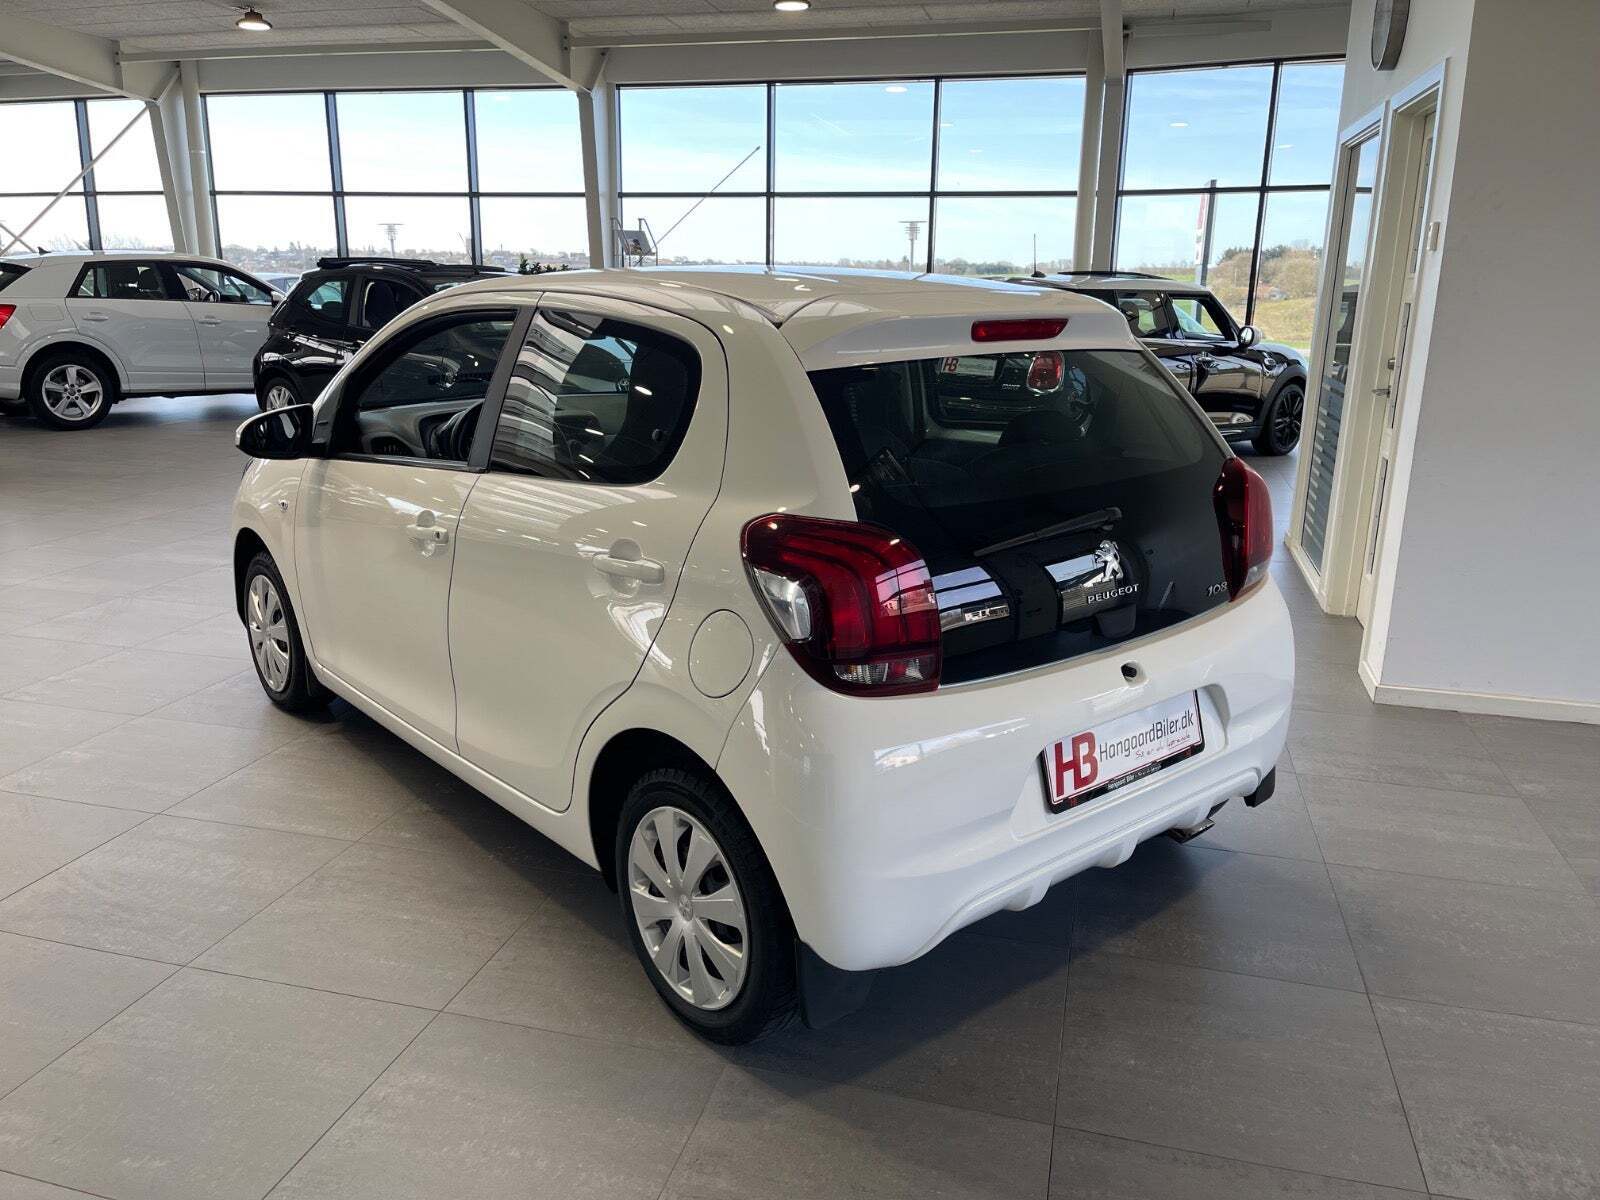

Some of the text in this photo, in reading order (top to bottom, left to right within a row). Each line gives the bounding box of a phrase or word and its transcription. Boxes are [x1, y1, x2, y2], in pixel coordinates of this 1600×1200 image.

[1087, 583, 1140, 604] PEUGEOT
[1207, 581, 1228, 597] 108
[1099, 709, 1195, 763] HangaardBiler.dk
[1054, 731, 1099, 798] HB
